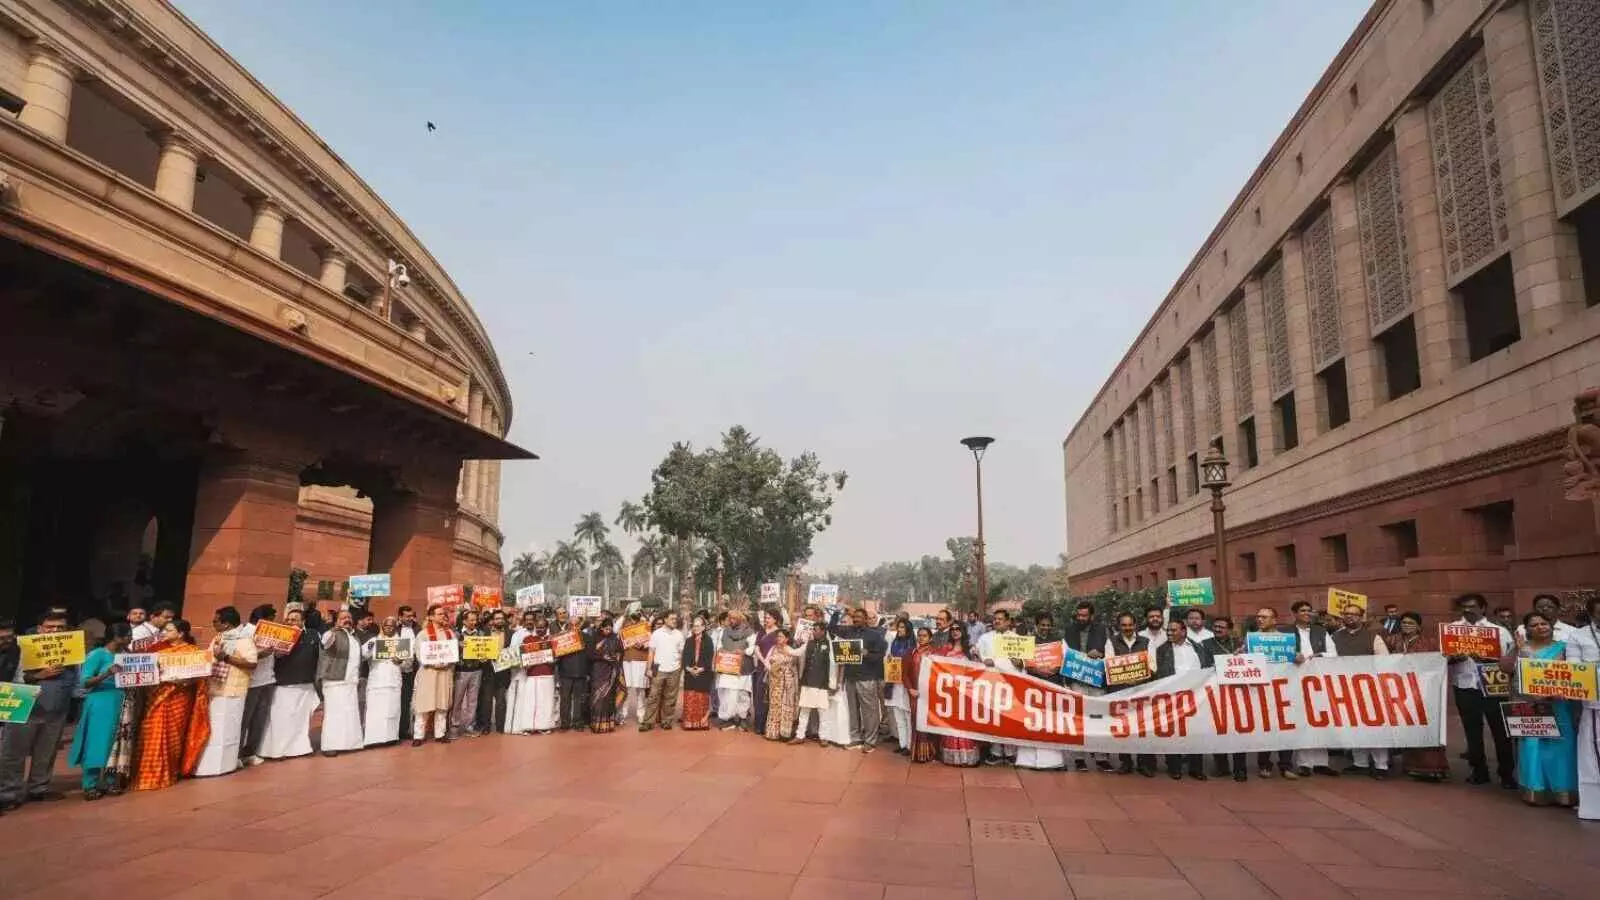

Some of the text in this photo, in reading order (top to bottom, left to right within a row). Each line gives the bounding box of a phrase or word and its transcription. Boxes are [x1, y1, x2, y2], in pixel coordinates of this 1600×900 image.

[836, 654, 860, 662] FRAUD
[1227, 658, 1245, 666] SIR
[1552, 662, 1568, 670] NO
[1544, 670, 1572, 680] SIR
[1532, 678, 1558, 686] SAVE
[1528, 684, 1590, 698] DEMOCRACY
[935, 671, 1014, 727] STOP
[1023, 688, 1077, 736] SIR
[1109, 690, 1197, 738] STOP
[1205, 679, 1296, 736] VOTE
[1301, 672, 1428, 729] CHORI
